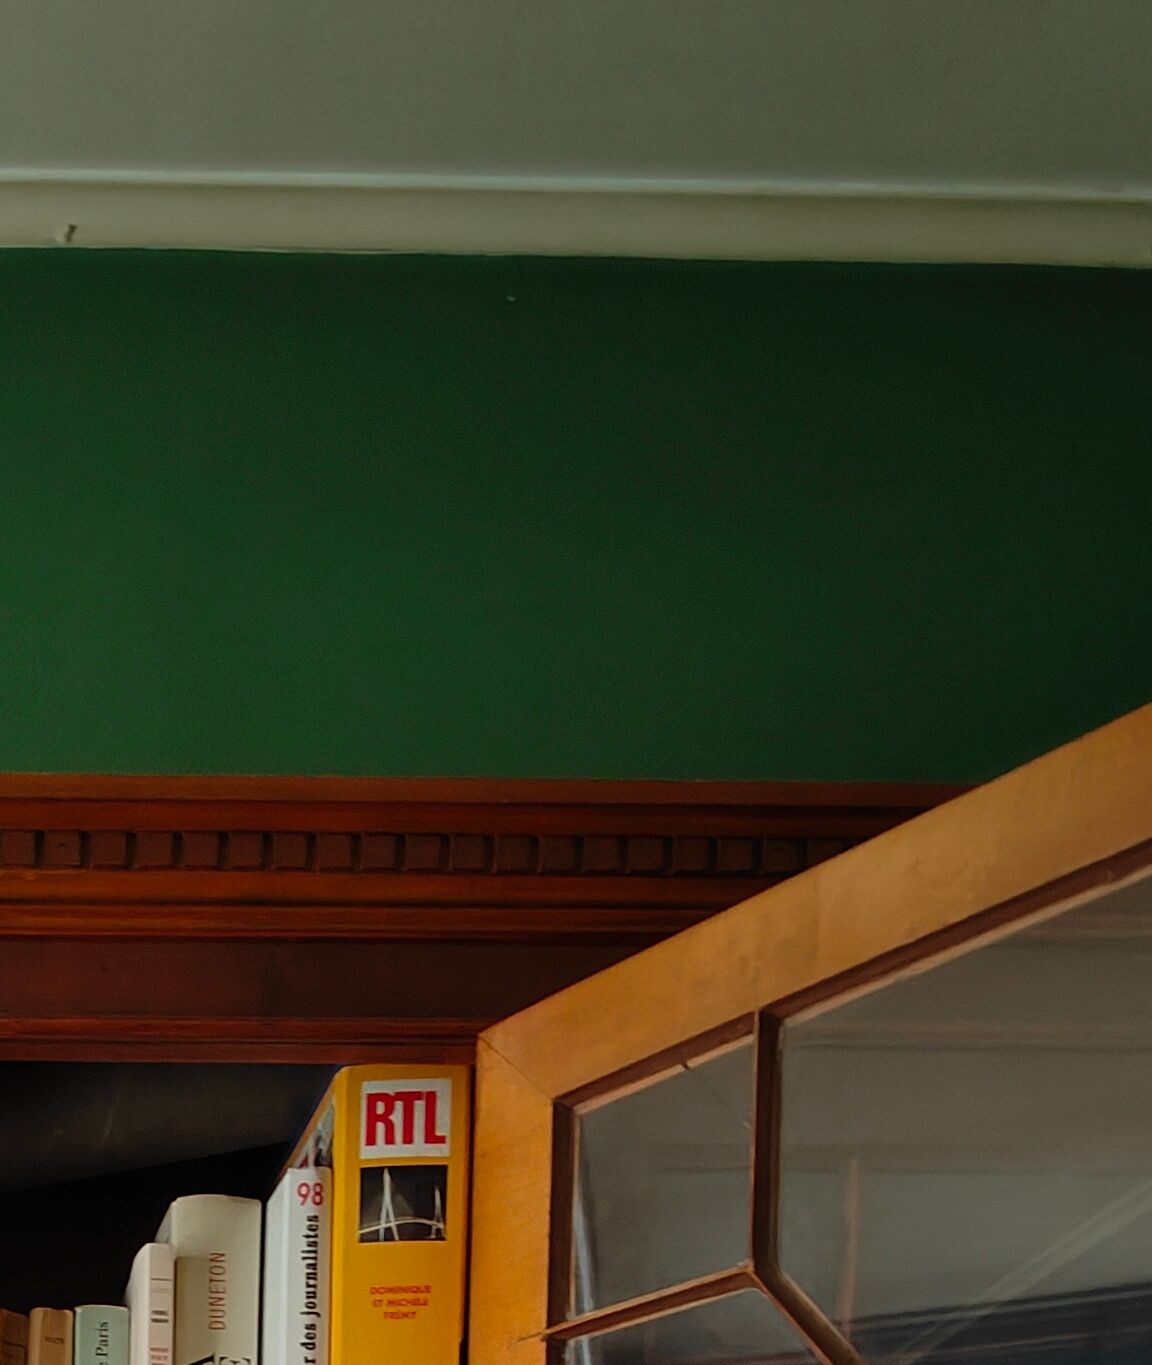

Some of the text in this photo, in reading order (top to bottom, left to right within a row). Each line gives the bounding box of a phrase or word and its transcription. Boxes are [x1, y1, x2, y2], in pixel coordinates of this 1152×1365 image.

[365, 1091, 447, 1147] RTL
[297, 1183, 323, 1206] 98
[300, 1214, 321, 1318] journalistes
[208, 1252, 226, 1331] DUNETON
[370, 1285, 432, 1297] DOMINIQUE
[95, 1321, 109, 1357] Paris
[299, 1322, 316, 1351] des
